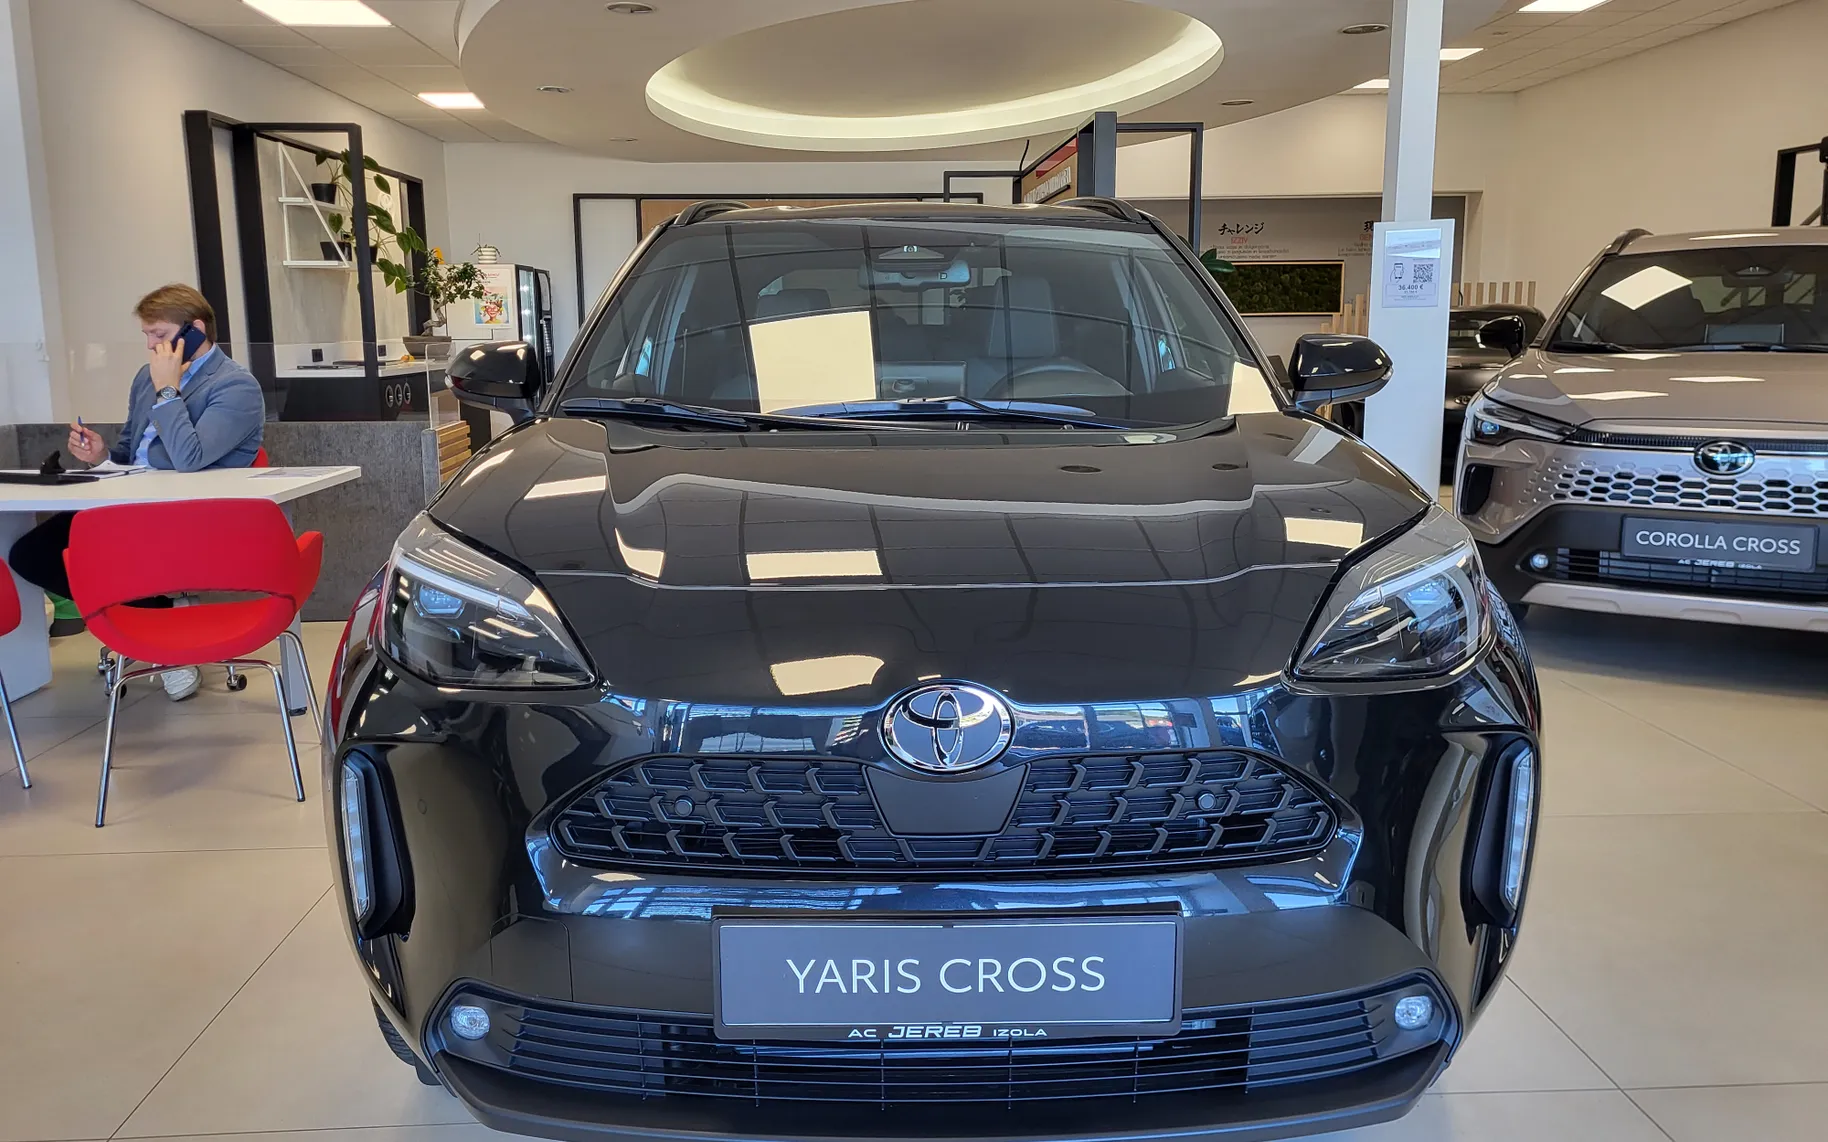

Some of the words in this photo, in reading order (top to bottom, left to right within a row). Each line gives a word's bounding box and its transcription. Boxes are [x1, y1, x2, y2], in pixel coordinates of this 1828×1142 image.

[1218, 222, 1265, 235] チャレンジ
[1636, 530, 1727, 550] COROLLA
[1733, 536, 1800, 555] CROSS
[786, 958, 921, 994] YARIS
[939, 956, 1105, 994] CROSS
[848, 1028, 877, 1038] AC
[888, 1025, 981, 1039] JEREB
[993, 1028, 1047, 1038] IZOLA
